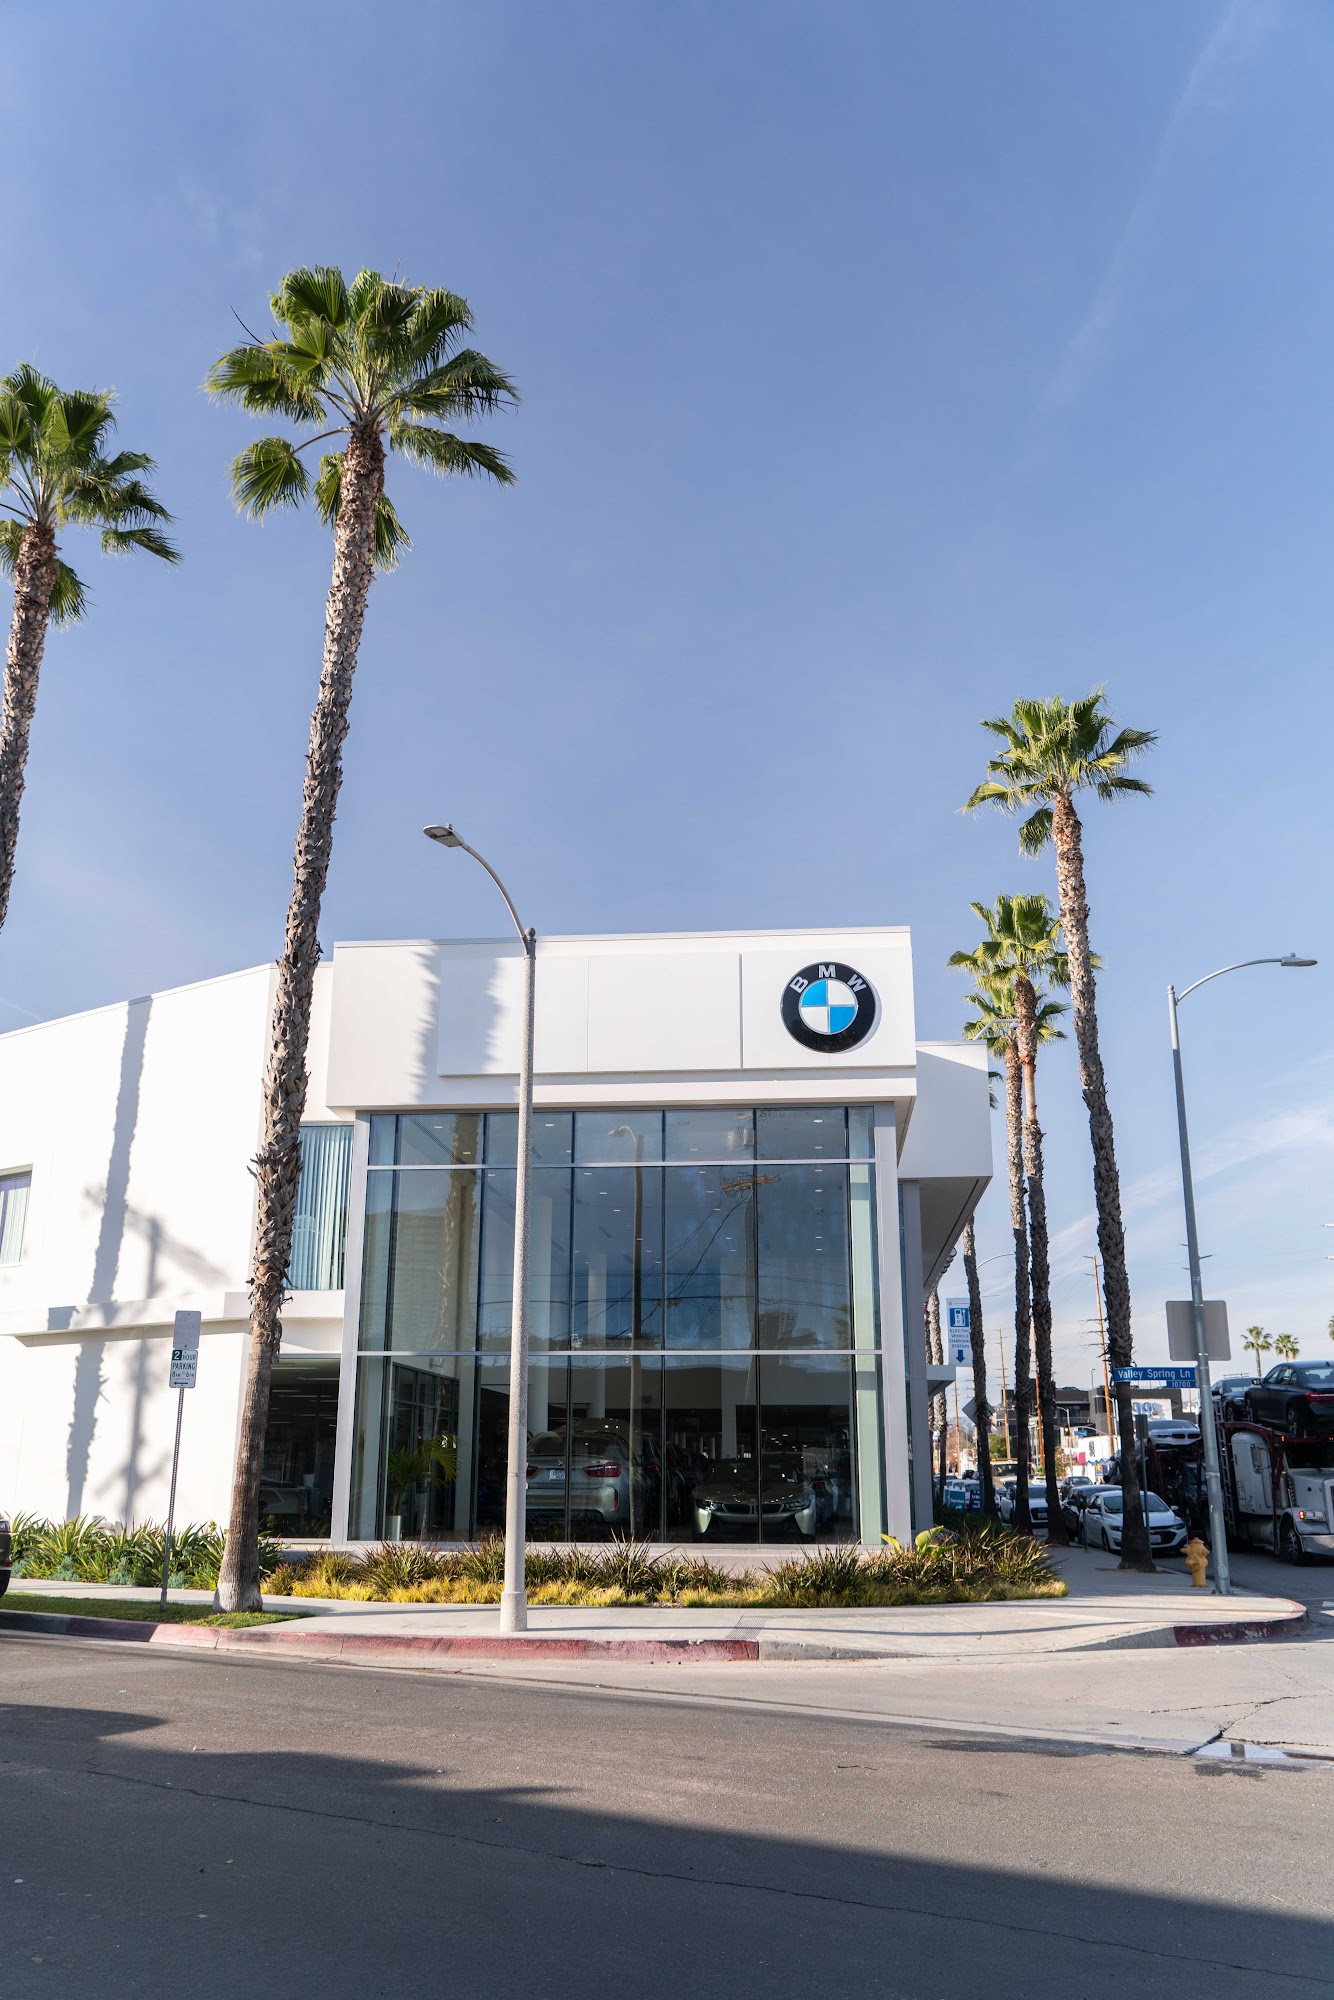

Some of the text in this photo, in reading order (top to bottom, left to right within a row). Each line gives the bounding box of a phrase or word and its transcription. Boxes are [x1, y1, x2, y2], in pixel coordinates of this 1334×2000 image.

[789, 964, 867, 994] BMW
[174, 1351, 180, 1360] 2
[1118, 1369, 1191, 1379] Valley Spring Ln
